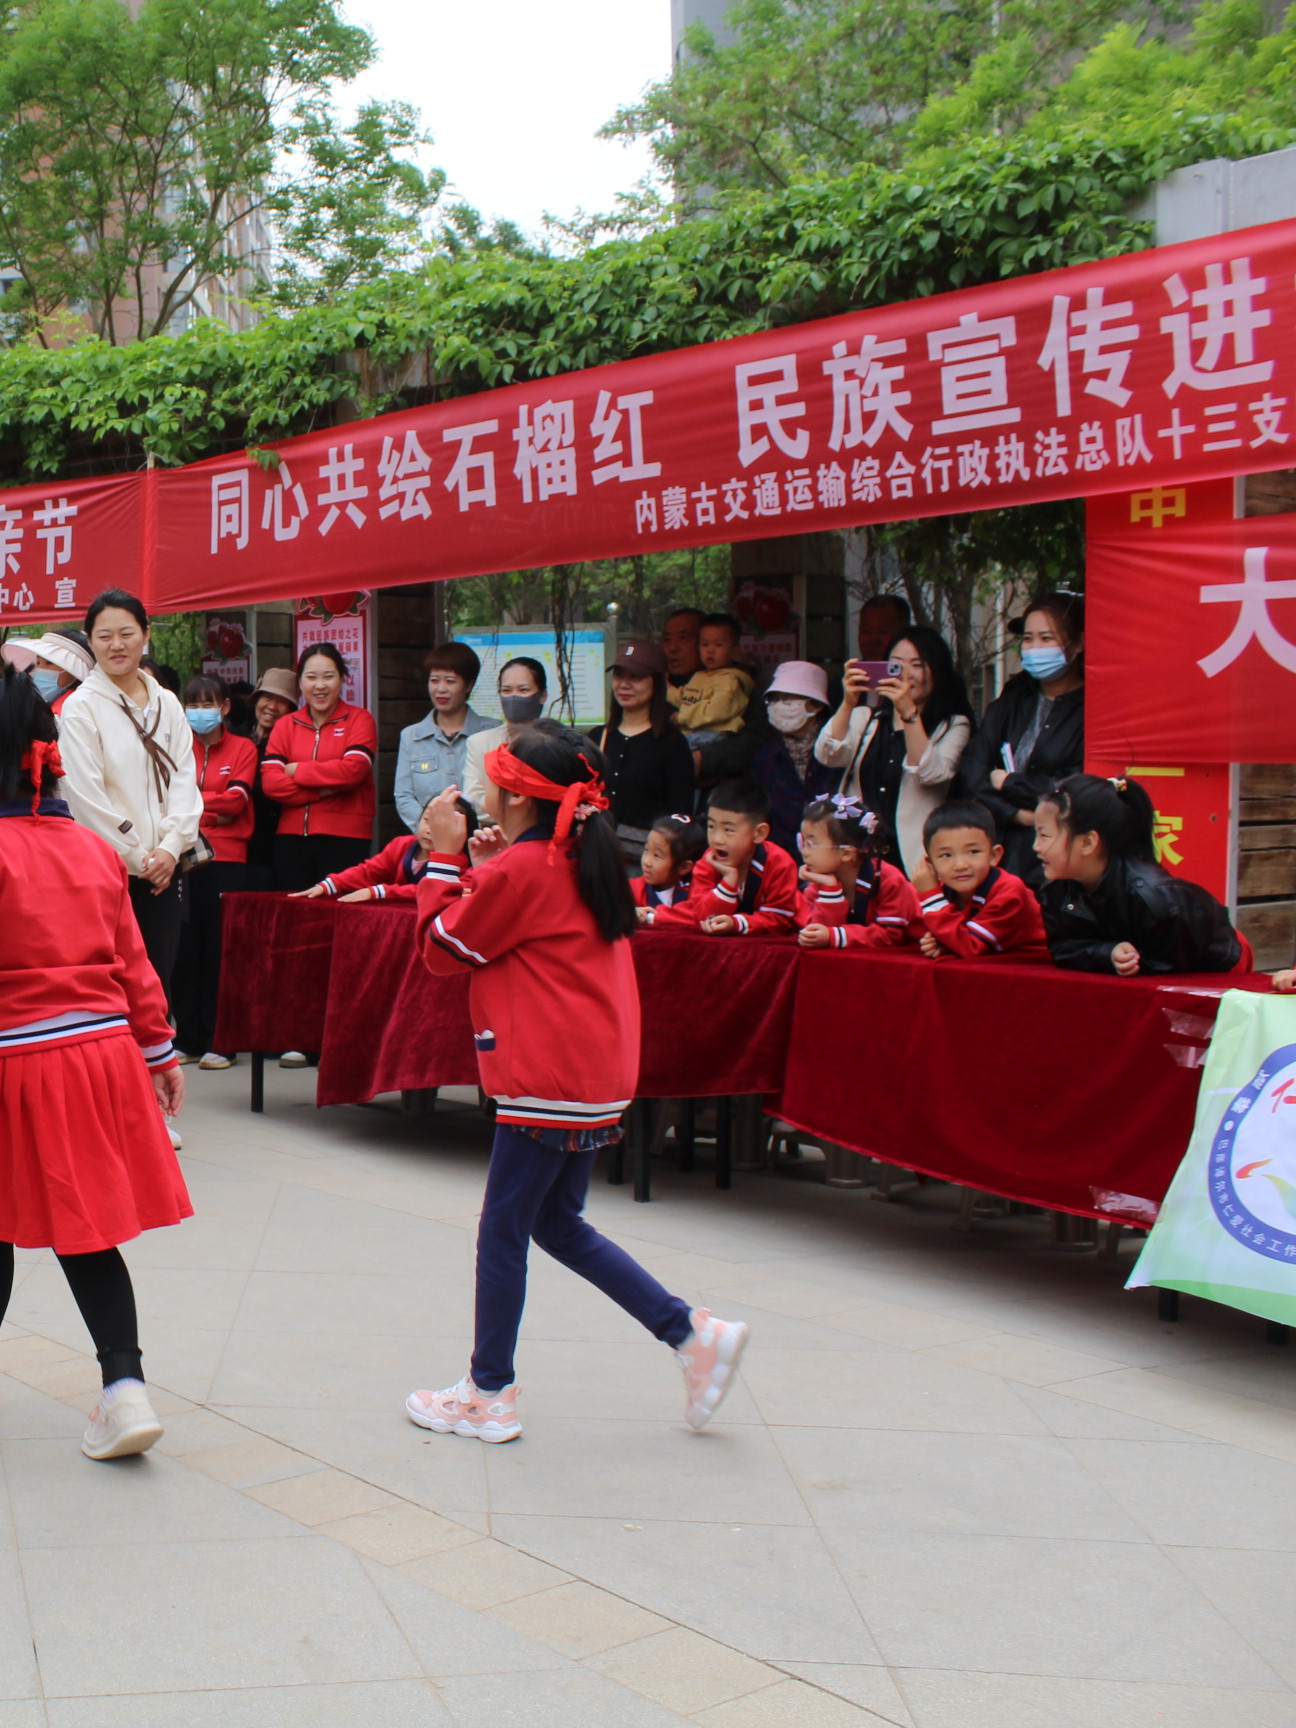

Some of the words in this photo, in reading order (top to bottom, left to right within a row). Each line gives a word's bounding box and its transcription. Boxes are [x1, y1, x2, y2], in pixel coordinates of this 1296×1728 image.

[210, 389, 662, 555] 同心共绘石榴红
[735, 257, 1275, 469] 民族宣传进
[635, 392, 1290, 534] 内蒙古交通运输综合行政执法总队十三支
[1130, 486, 1186, 528] 中
[54, 577, 77, 609] 宣
[1196, 546, 1296, 679] 大
